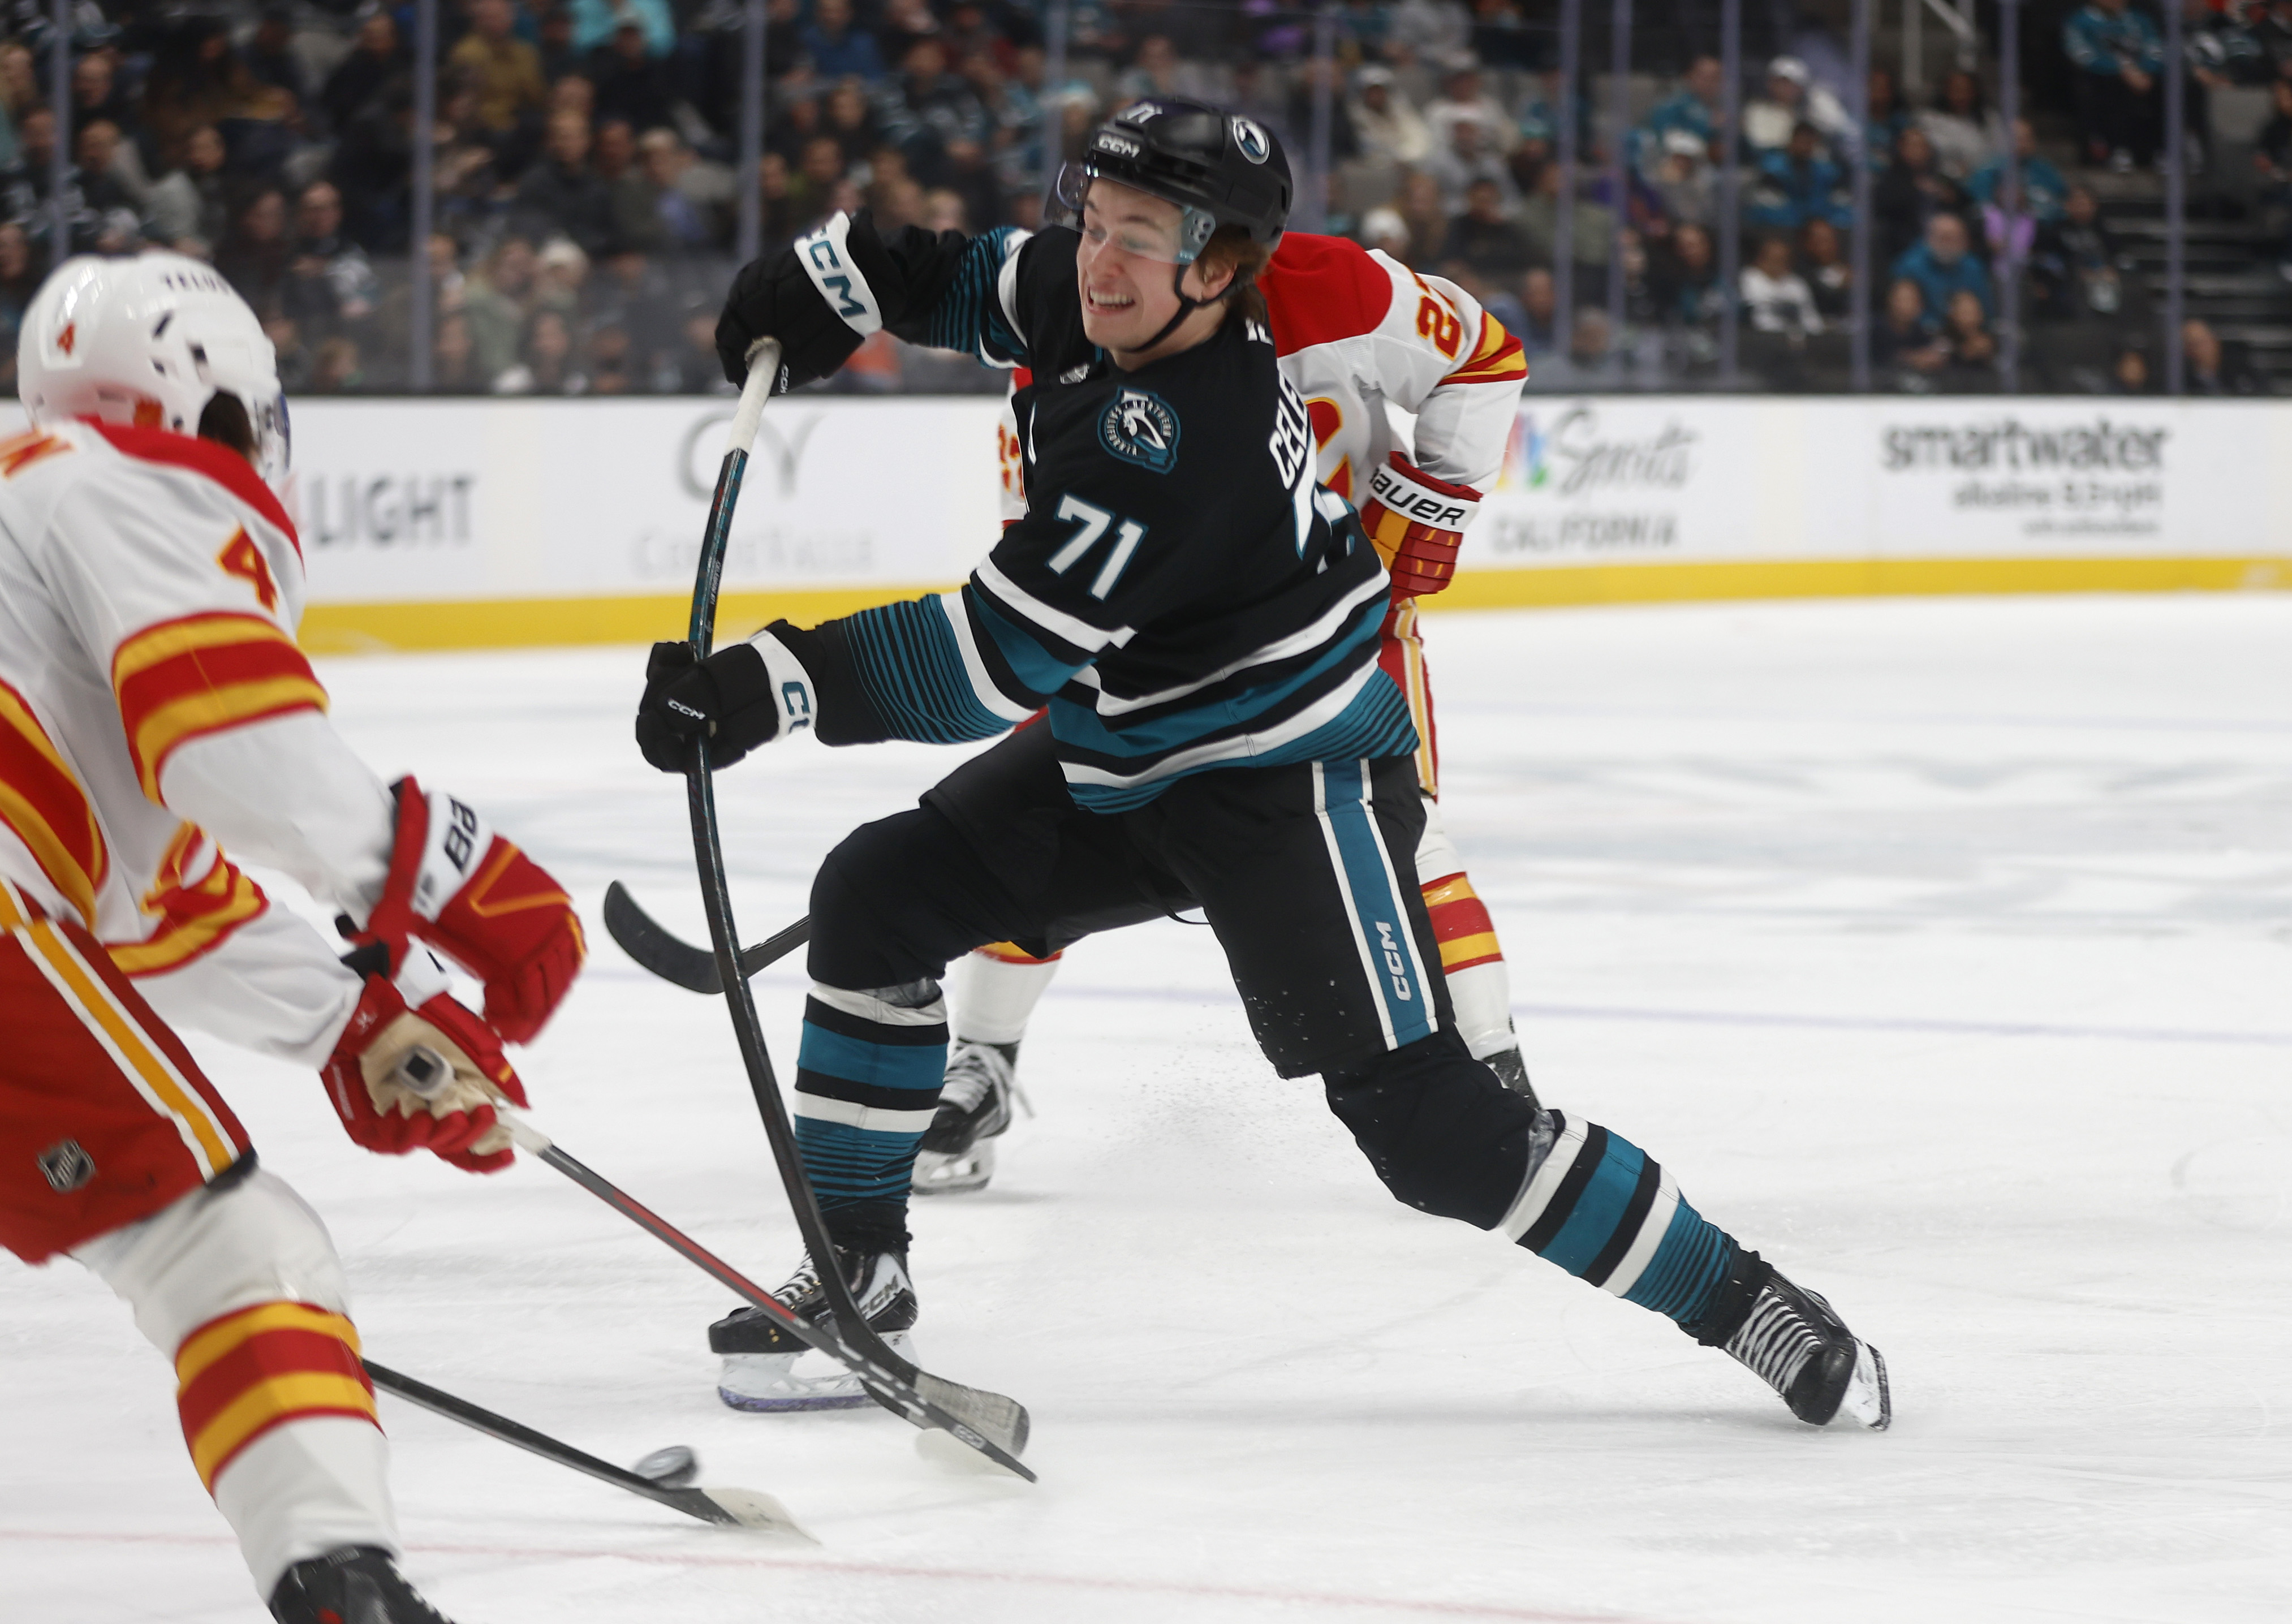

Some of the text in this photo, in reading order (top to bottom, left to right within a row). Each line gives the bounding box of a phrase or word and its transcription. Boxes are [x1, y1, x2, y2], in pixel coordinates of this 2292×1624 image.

[1098, 133, 1140, 158] CCM
[805, 226, 868, 317] CM
[57, 321, 75, 356] 4
[780, 364, 789, 394] CCM
[1882, 417, 2169, 471] smartwater
[310, 474, 476, 544] LIGHT
[215, 523, 277, 614] 4
[1046, 493, 1148, 602] 71
[668, 699, 706, 720] CCM
[1375, 921, 1411, 1001] CCM
